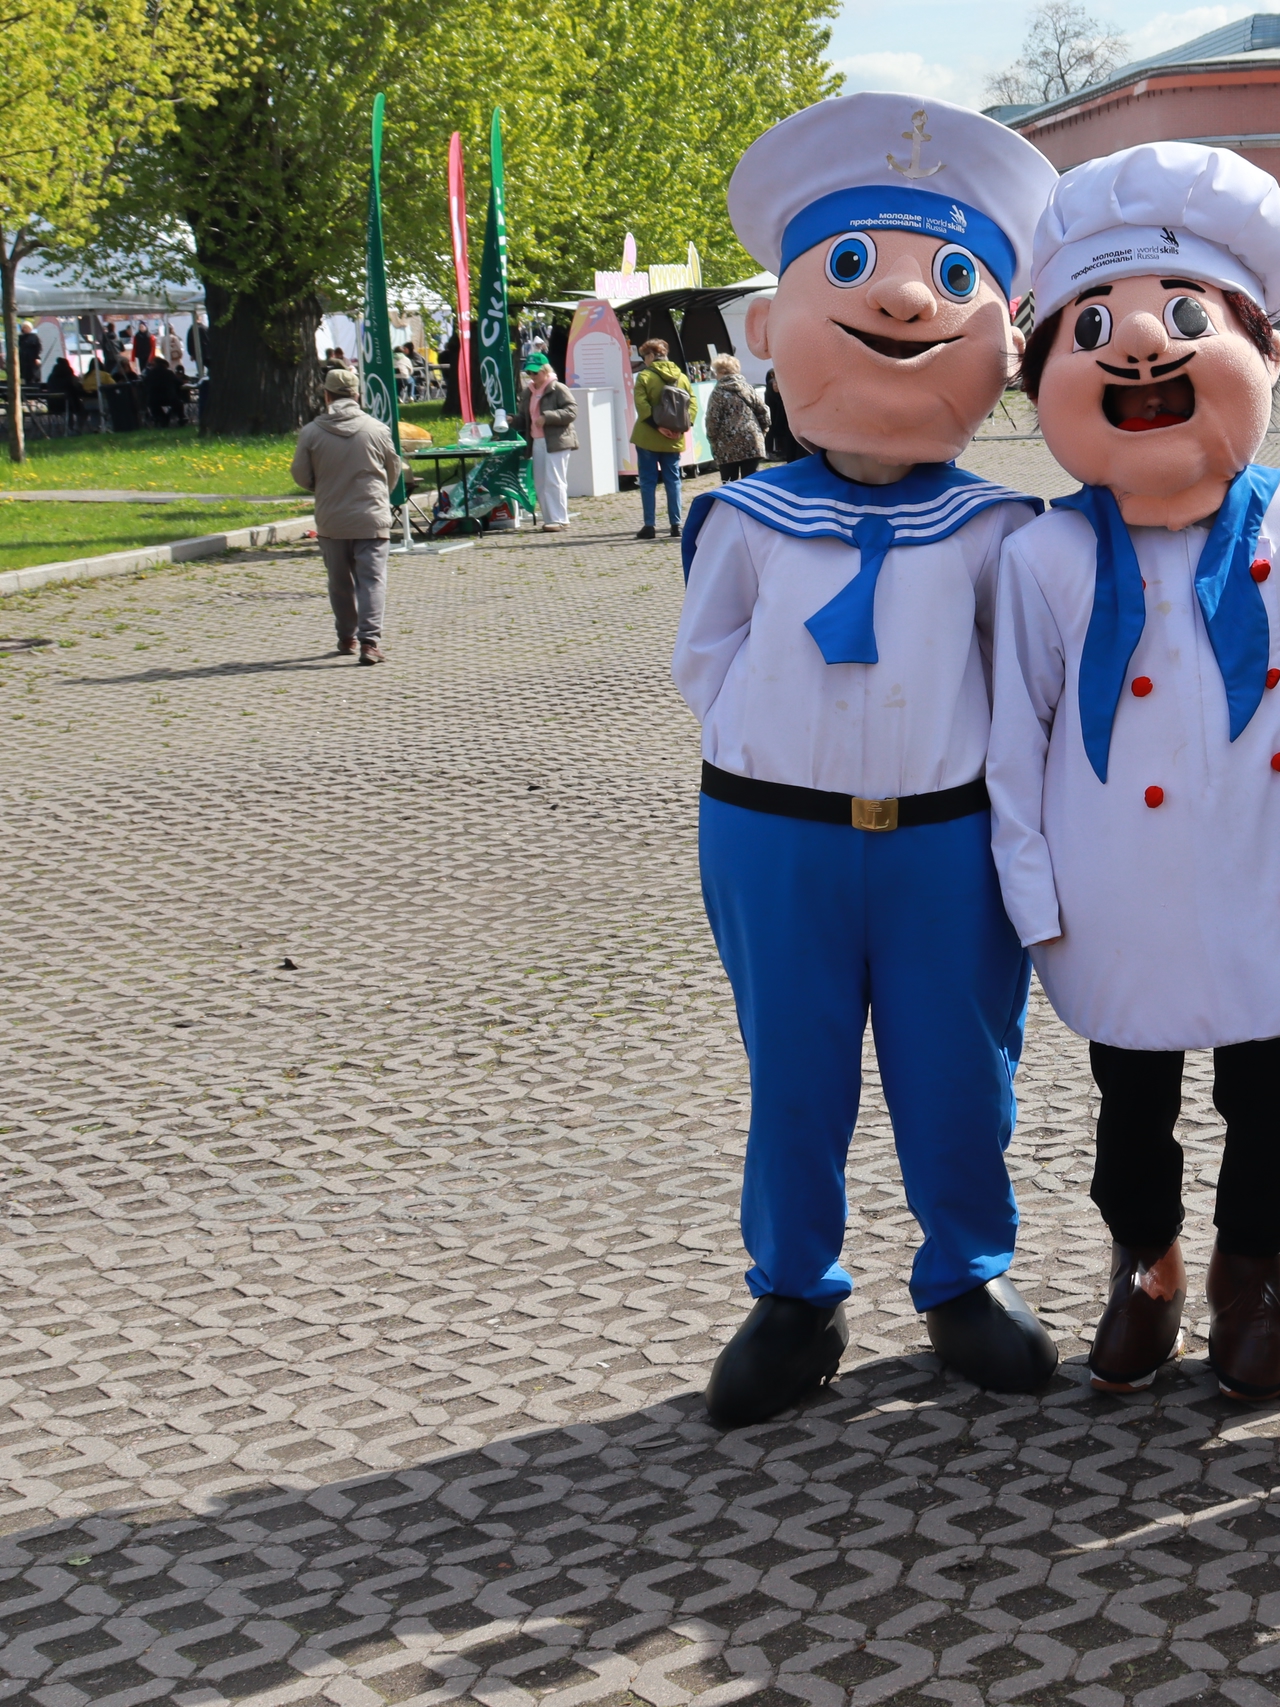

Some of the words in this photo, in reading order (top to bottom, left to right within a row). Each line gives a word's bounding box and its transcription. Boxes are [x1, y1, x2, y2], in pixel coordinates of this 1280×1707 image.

[850, 217, 922, 228] профессионалы
[879, 213, 922, 221] молодые
[926, 217, 947, 228] world
[947, 222, 966, 234] skills
[926, 223, 947, 233] Russia
[1092, 248, 1132, 262] молодые
[1137, 245, 1159, 254] world
[1160, 246, 1179, 255] skills
[1071, 255, 1133, 280] профессионалы
